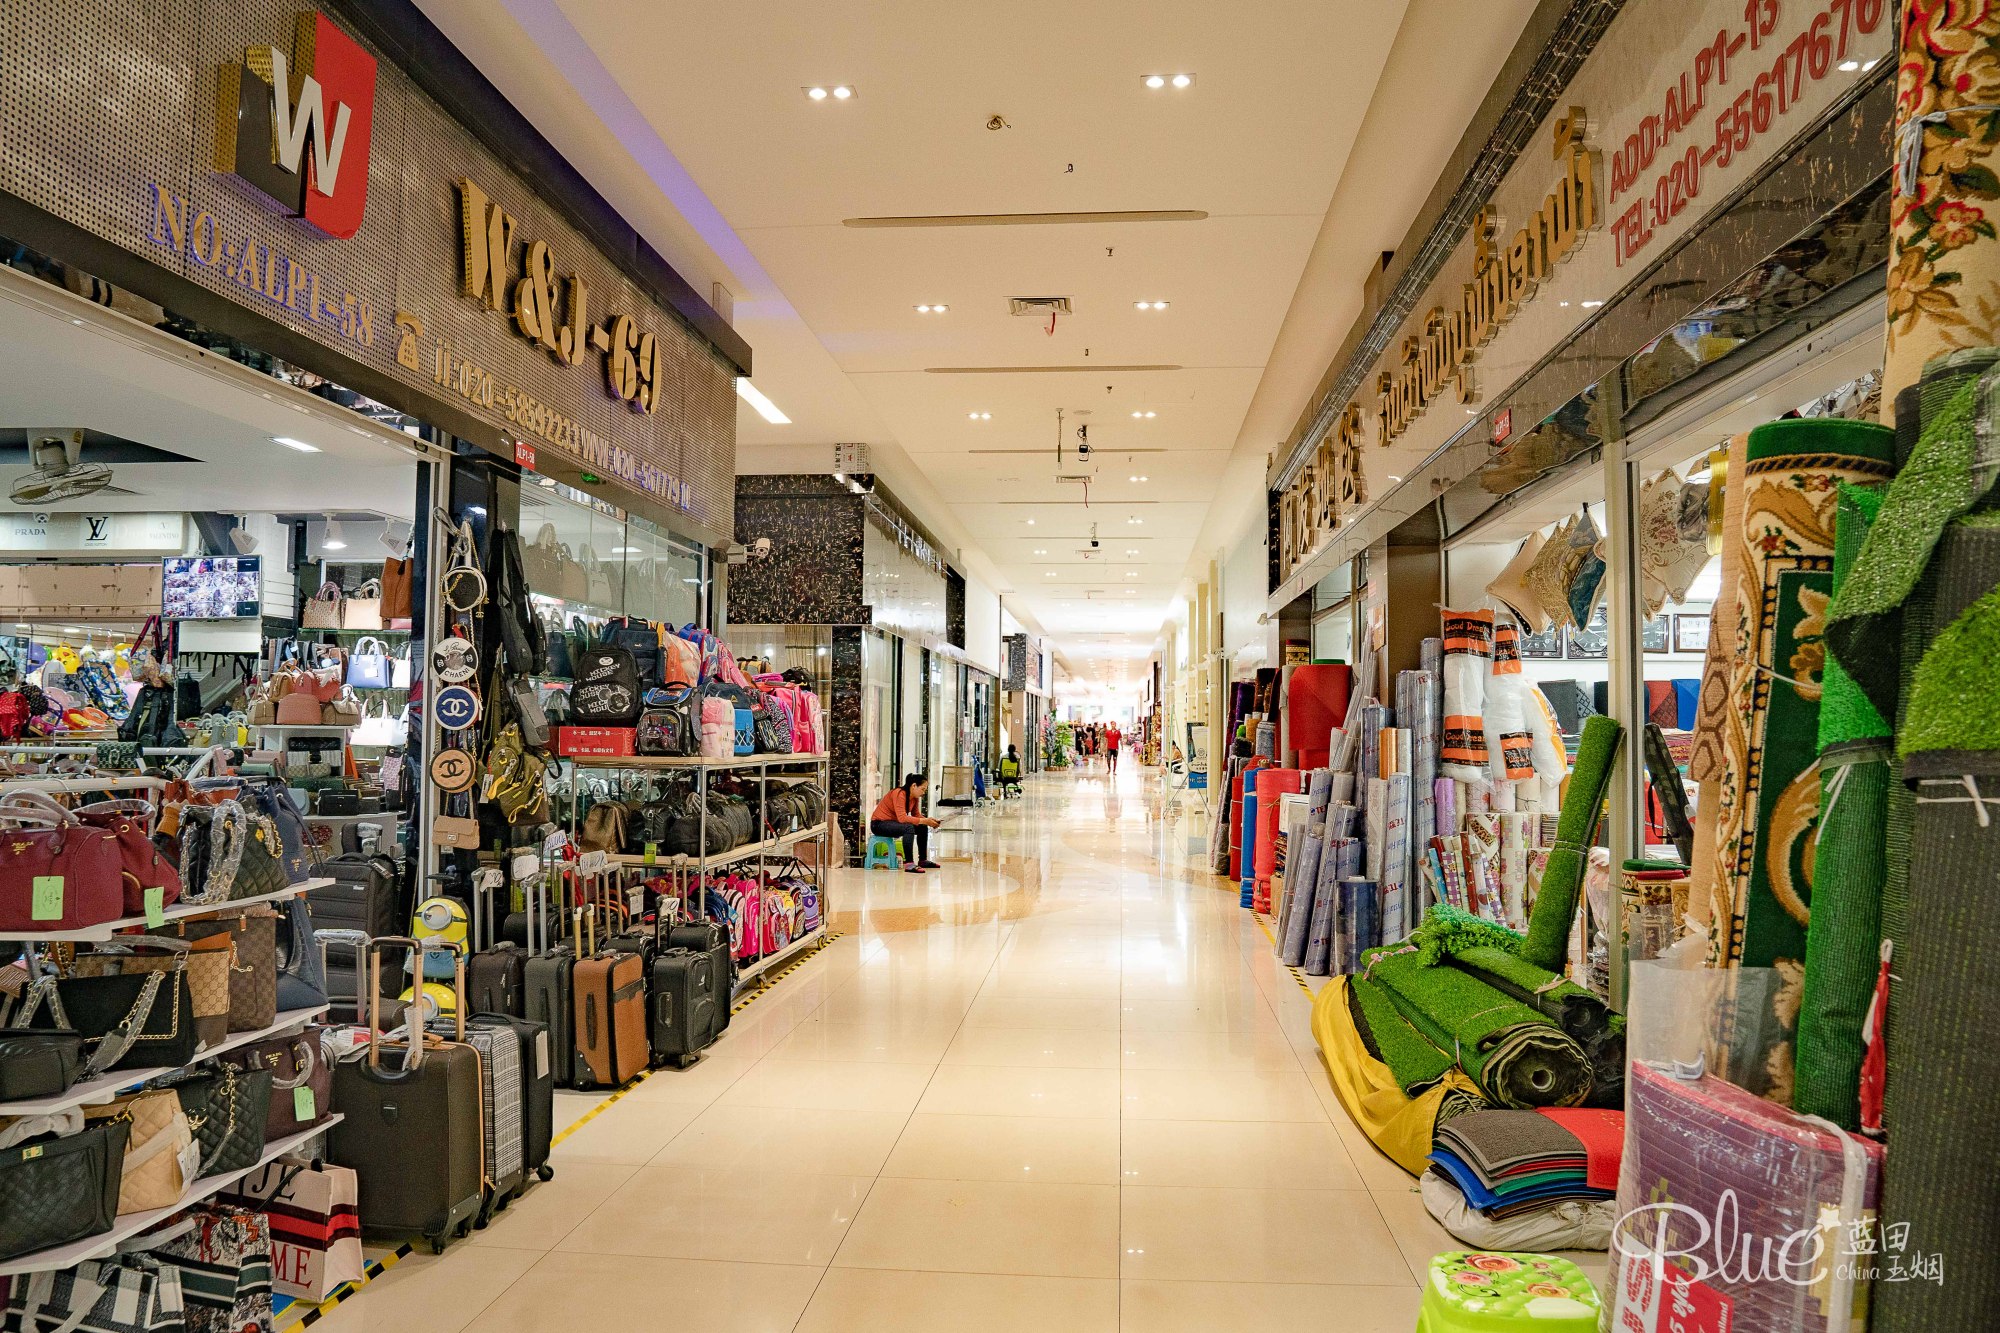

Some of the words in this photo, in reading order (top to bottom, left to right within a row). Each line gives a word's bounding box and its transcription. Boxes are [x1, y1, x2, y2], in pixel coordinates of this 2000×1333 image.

[147, 183, 374, 348] NO:ALP1-58
[459, 176, 662, 416] W&J-69
[14, 528, 47, 536] PRADA
